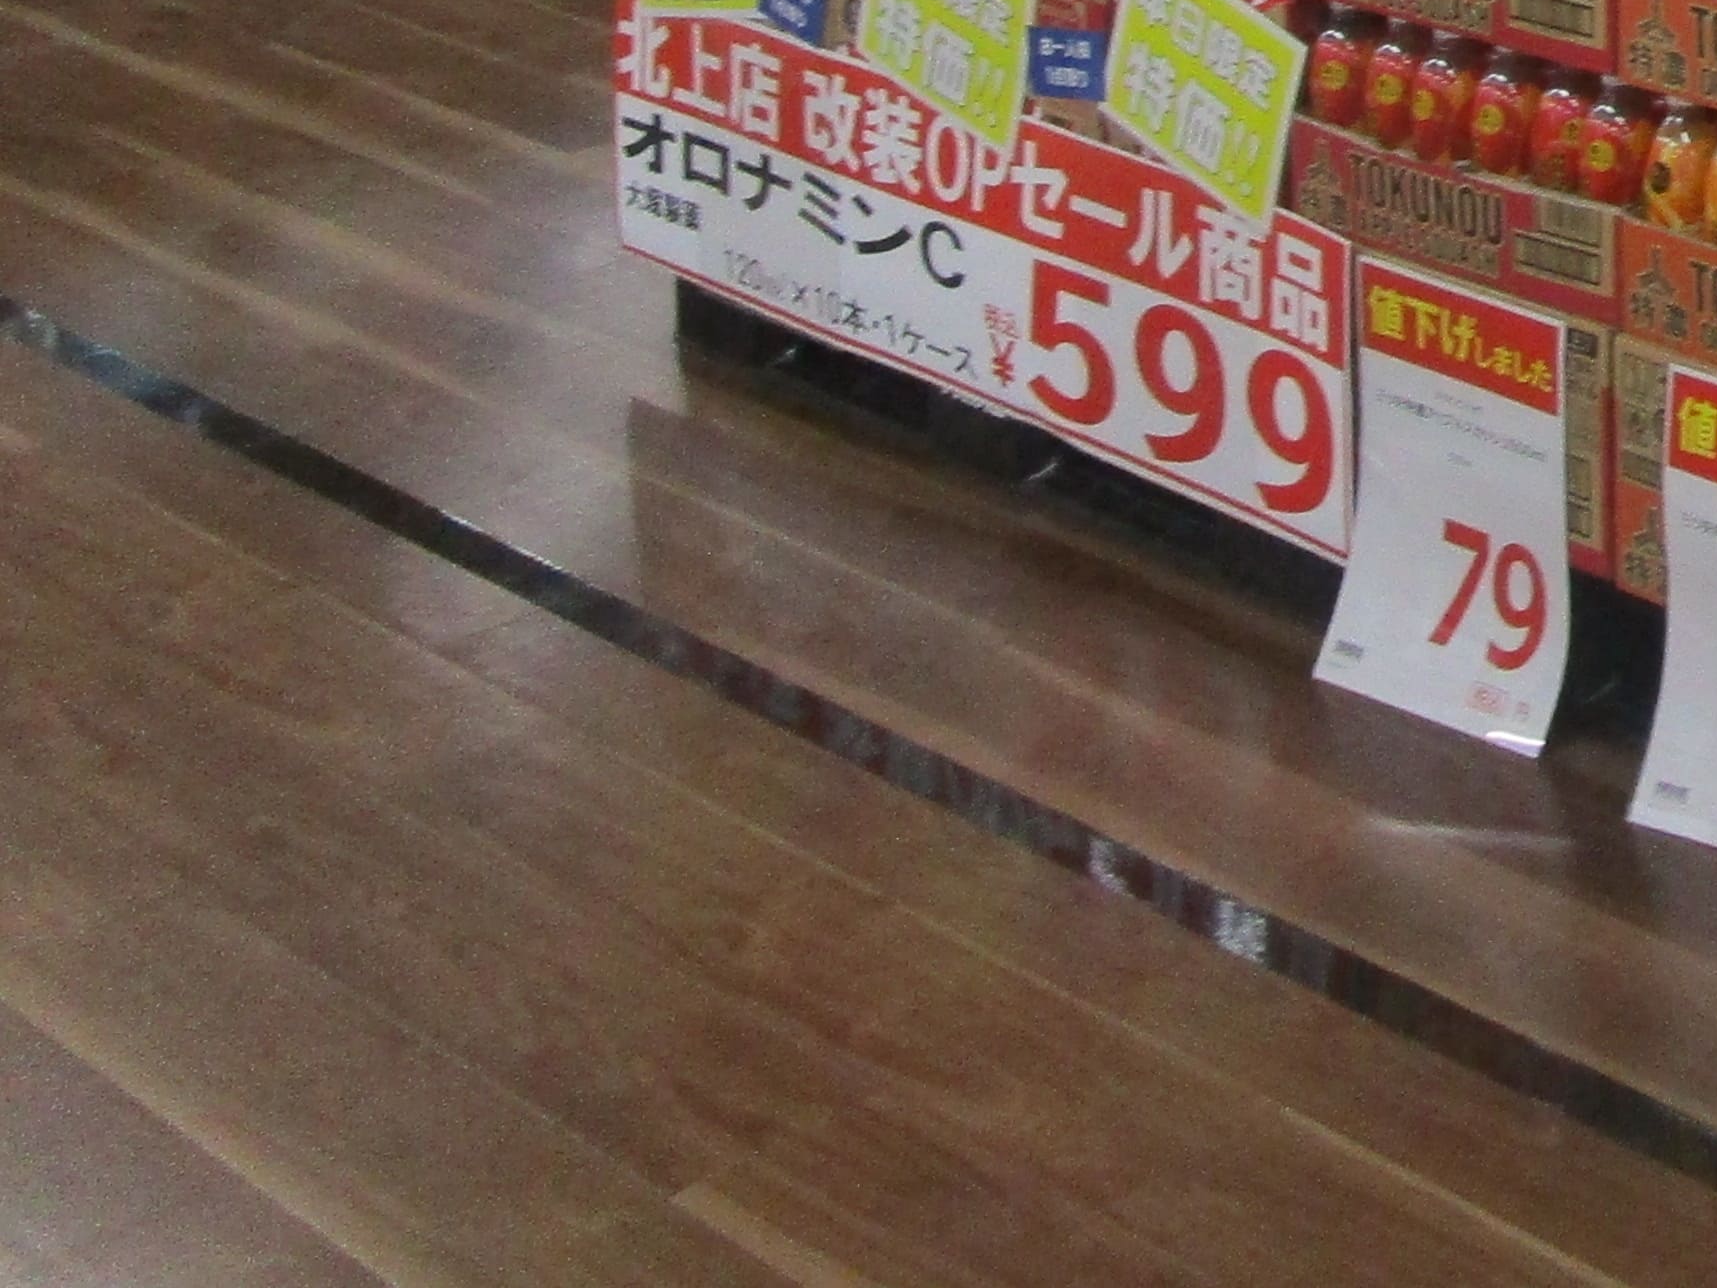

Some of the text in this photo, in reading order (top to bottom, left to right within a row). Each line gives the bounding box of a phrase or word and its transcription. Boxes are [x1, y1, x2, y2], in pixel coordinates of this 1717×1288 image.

[617, 15, 1330, 355] 北上店 改装OPセール商品
[622, 112, 966, 290] オロナミンC
[1349, 151, 1503, 247] TOKUNOU
[1368, 283, 1554, 394] 値下げしました
[1428, 517, 1549, 672] 79
